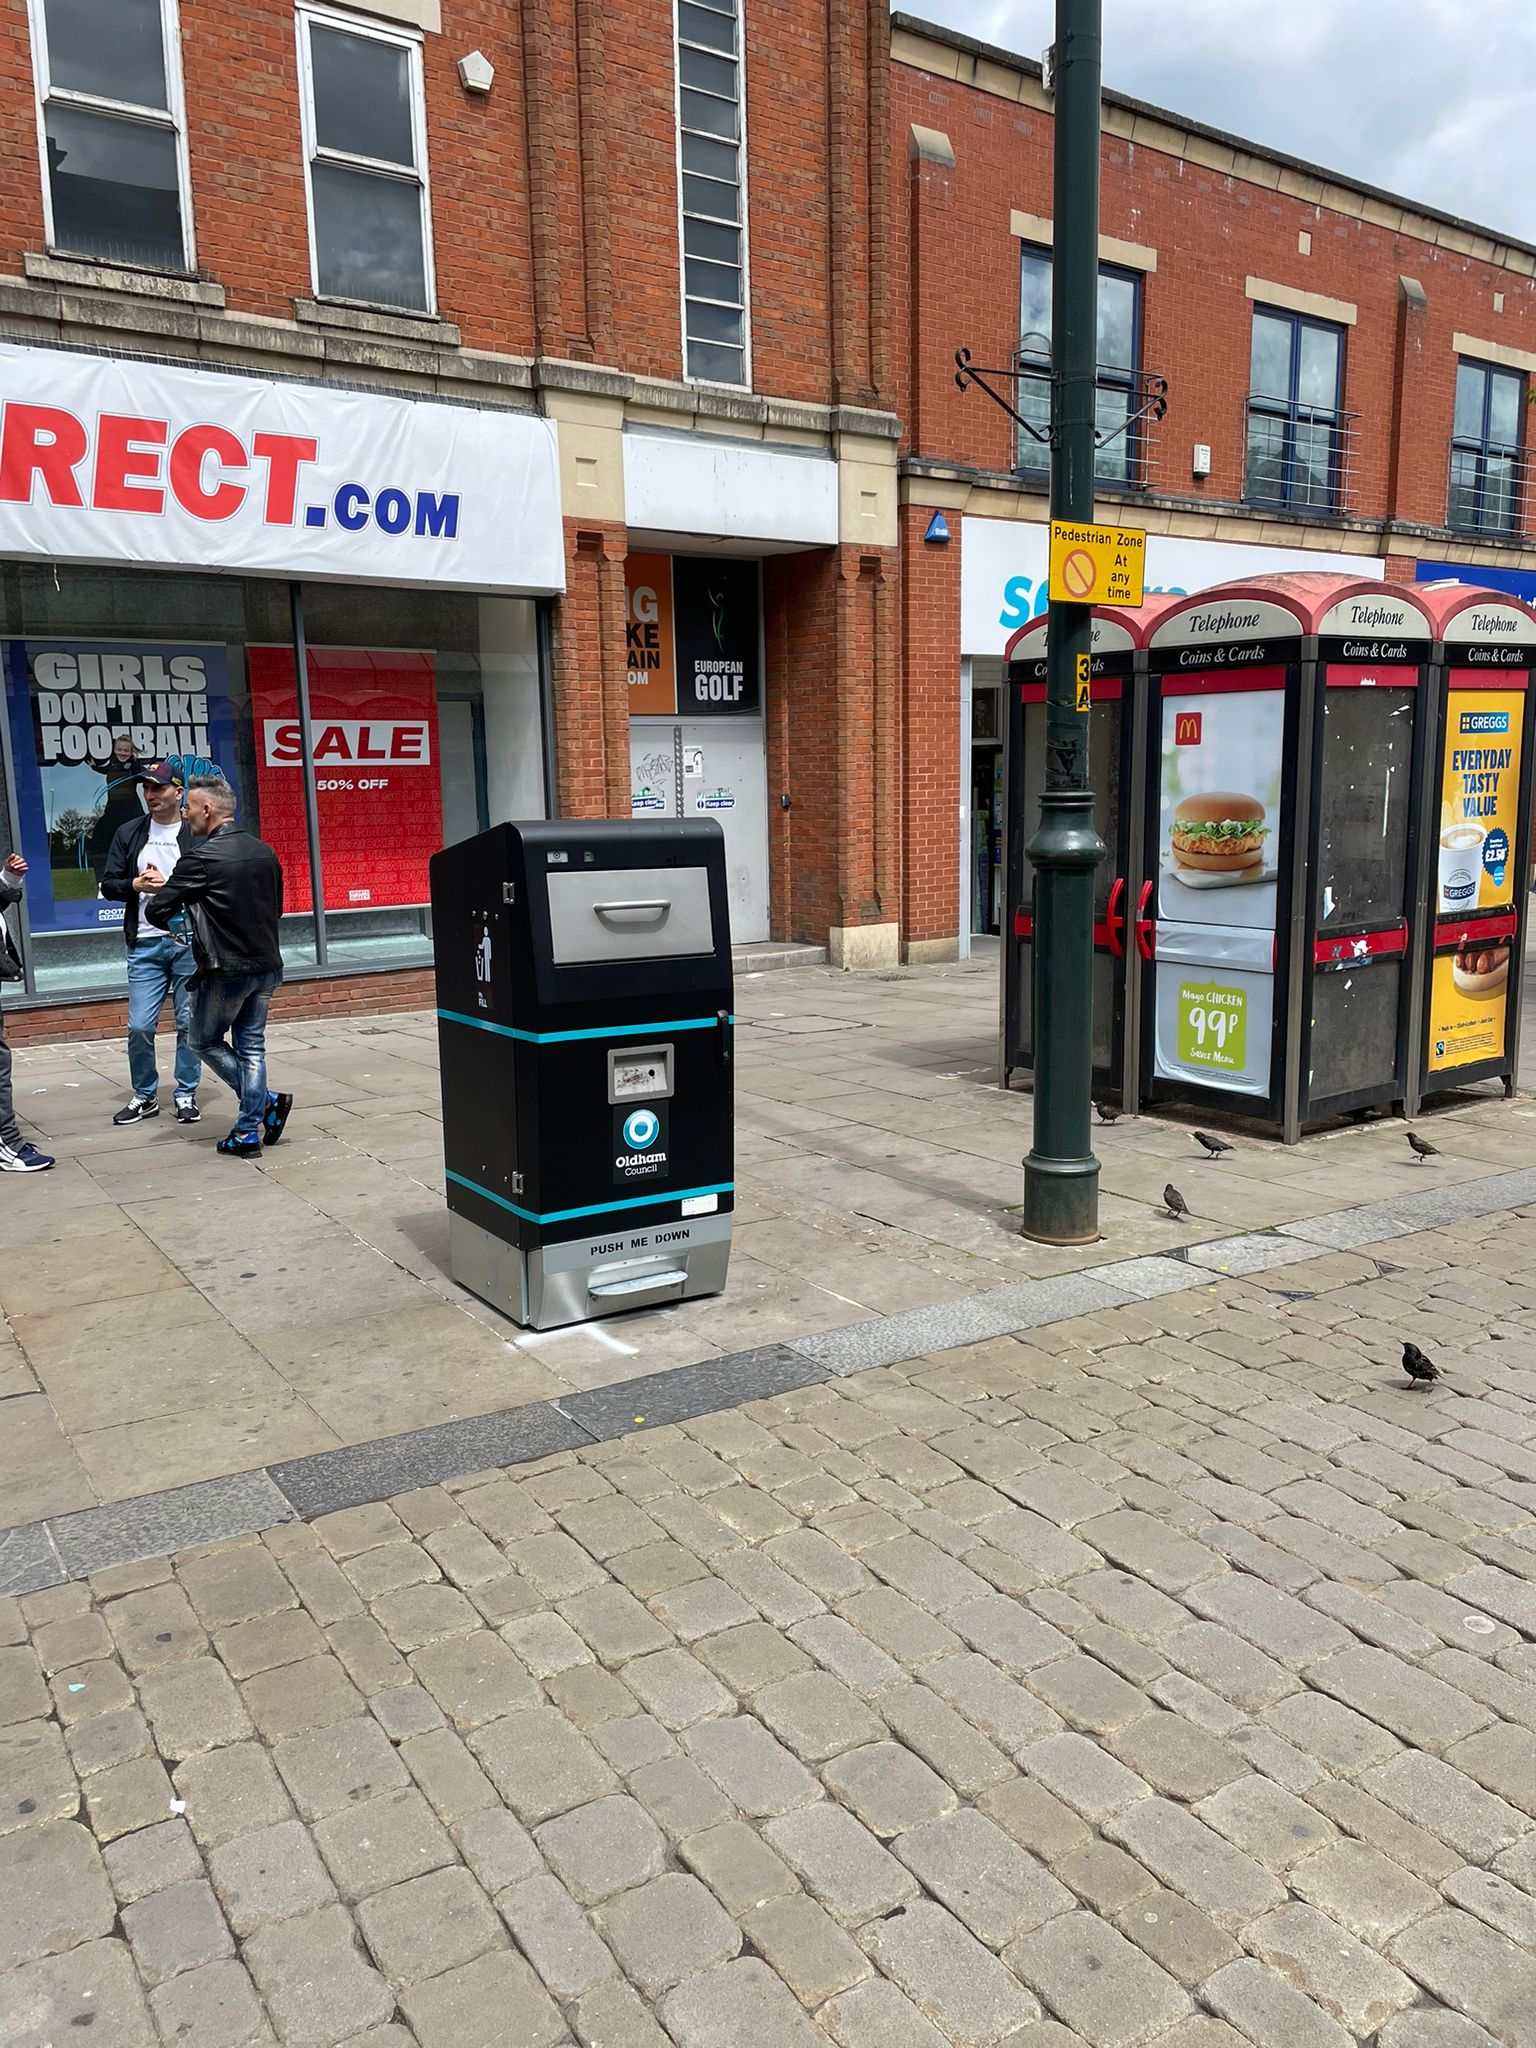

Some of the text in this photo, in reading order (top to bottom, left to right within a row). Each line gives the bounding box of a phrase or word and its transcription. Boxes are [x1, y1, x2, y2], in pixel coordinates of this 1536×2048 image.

[1054, 526, 1143, 548] Pedestrian Zone
[1114, 554, 1128, 567] At
[1111, 572, 1130, 586] any
[1107, 586, 1131, 599] time
[1189, 612, 1260, 634] Telephone
[1351, 605, 1405, 628] Telephone
[1471, 614, 1518, 635] Telephone
[1179, 645, 1266, 665] Coins & Cards
[1342, 641, 1408, 659] Coins & Cards
[1468, 647, 1524, 663] Coins & Cards
[33, 652, 208, 693] GIRLS
[694, 660, 744, 674] EUROPEAN
[1078, 658, 1090, 682] 3
[694, 673, 744, 702] GOLF
[1077, 685, 1090, 709] A
[37, 692, 209, 724] DON'T LIKE
[1470, 715, 1508, 730] GREGGS
[270, 724, 425, 761] SALE
[1451, 748, 1513, 772] EVERYDAY
[316, 778, 390, 791] 50% OFF
[1462, 772, 1501, 795] TASTY
[720, 800, 733, 808] clear
[1462, 795, 1499, 818] VALUE
[1448, 884, 1476, 899] GREGGS
[1181, 989, 1243, 1006] Mayo CHICKEN
[1190, 1047, 1235, 1064] Saver Menu
[615, 1152, 667, 1168] Oldham
[624, 1163, 658, 1176] Council
[590, 1229, 690, 1256] PUSH ME DOWN
